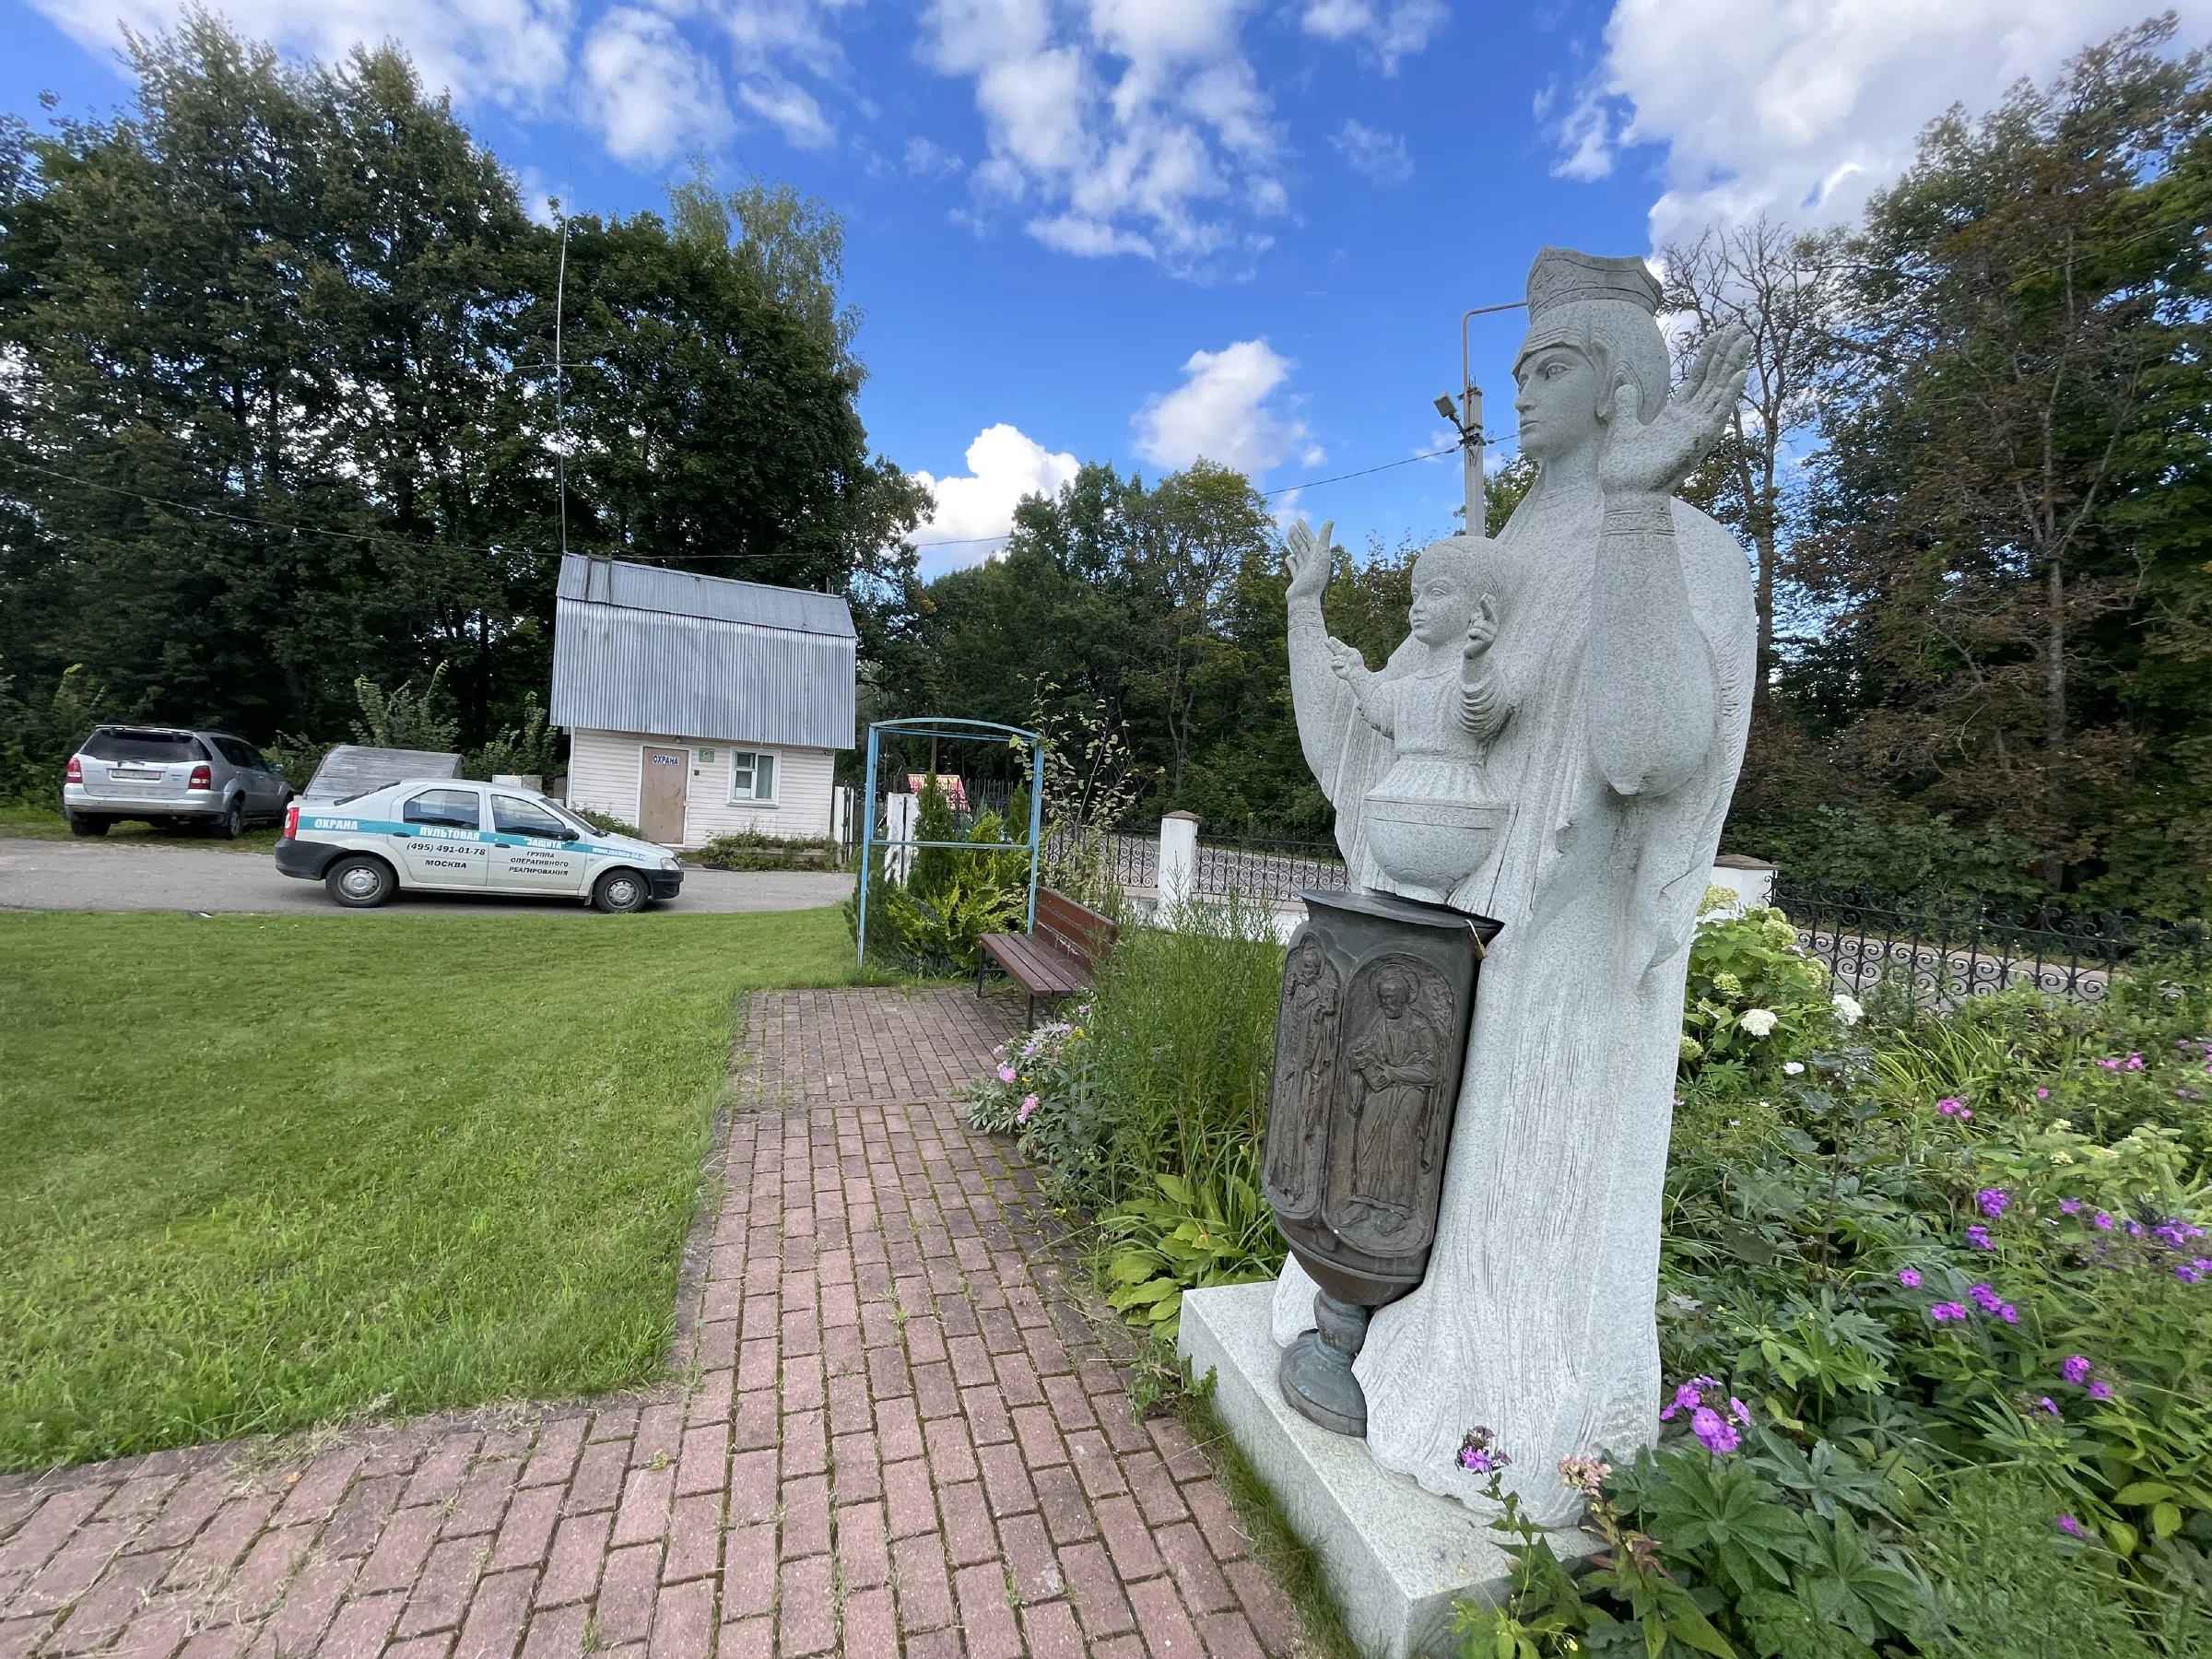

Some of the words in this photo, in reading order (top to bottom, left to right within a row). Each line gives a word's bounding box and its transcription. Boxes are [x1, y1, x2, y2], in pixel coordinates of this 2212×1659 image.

[653, 755, 678, 765] ОХРАНА
[314, 818, 358, 830] ОХРАНА
[419, 827, 480, 841] ПУЛЬТОВАЯ
[406, 842, 433, 852] (495)
[436, 844, 486, 855] 491-01-78
[425, 859, 467, 868] МОСКВА
[511, 857, 569, 867] ОПЕРАТИВНОГО
[509, 866, 569, 876] РЕАГИРОВАНИЯ
